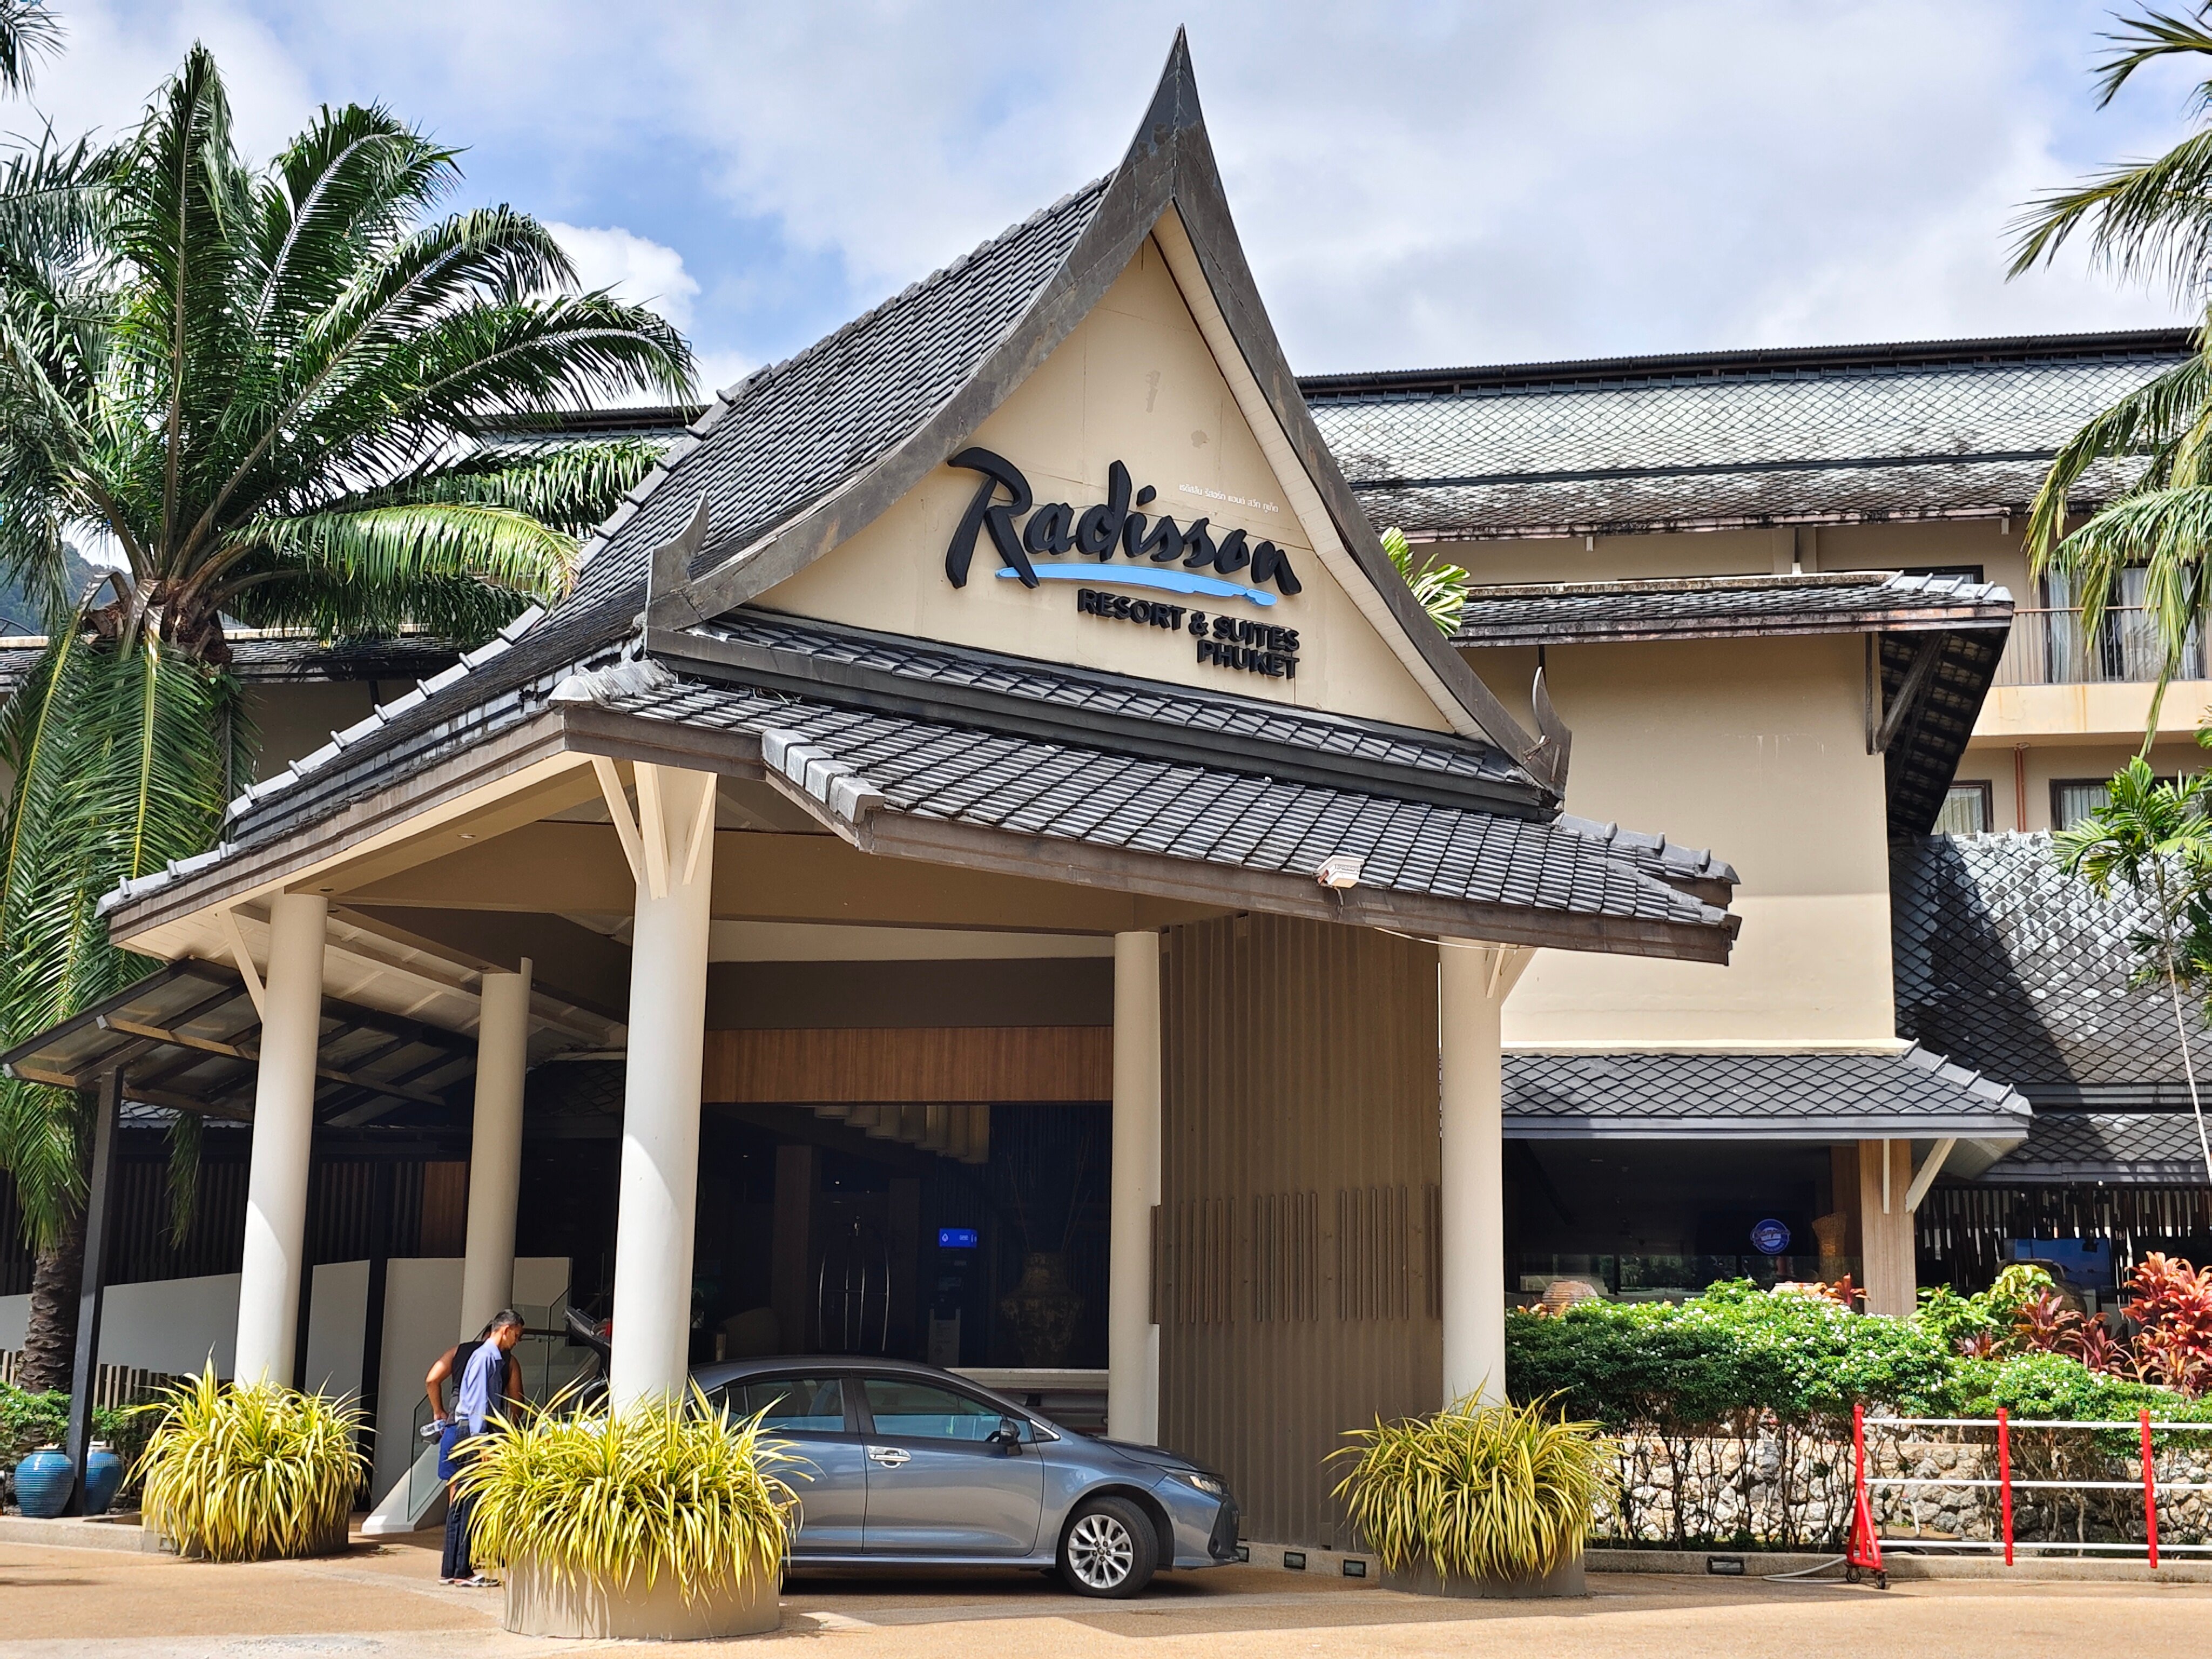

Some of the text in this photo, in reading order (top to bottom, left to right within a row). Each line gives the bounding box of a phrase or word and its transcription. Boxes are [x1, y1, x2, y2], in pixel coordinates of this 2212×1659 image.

[946, 447, 1301, 594] Radisson
[1077, 588, 1300, 652] RESORT & SUITES
[1197, 639, 1300, 679] PHUKET
